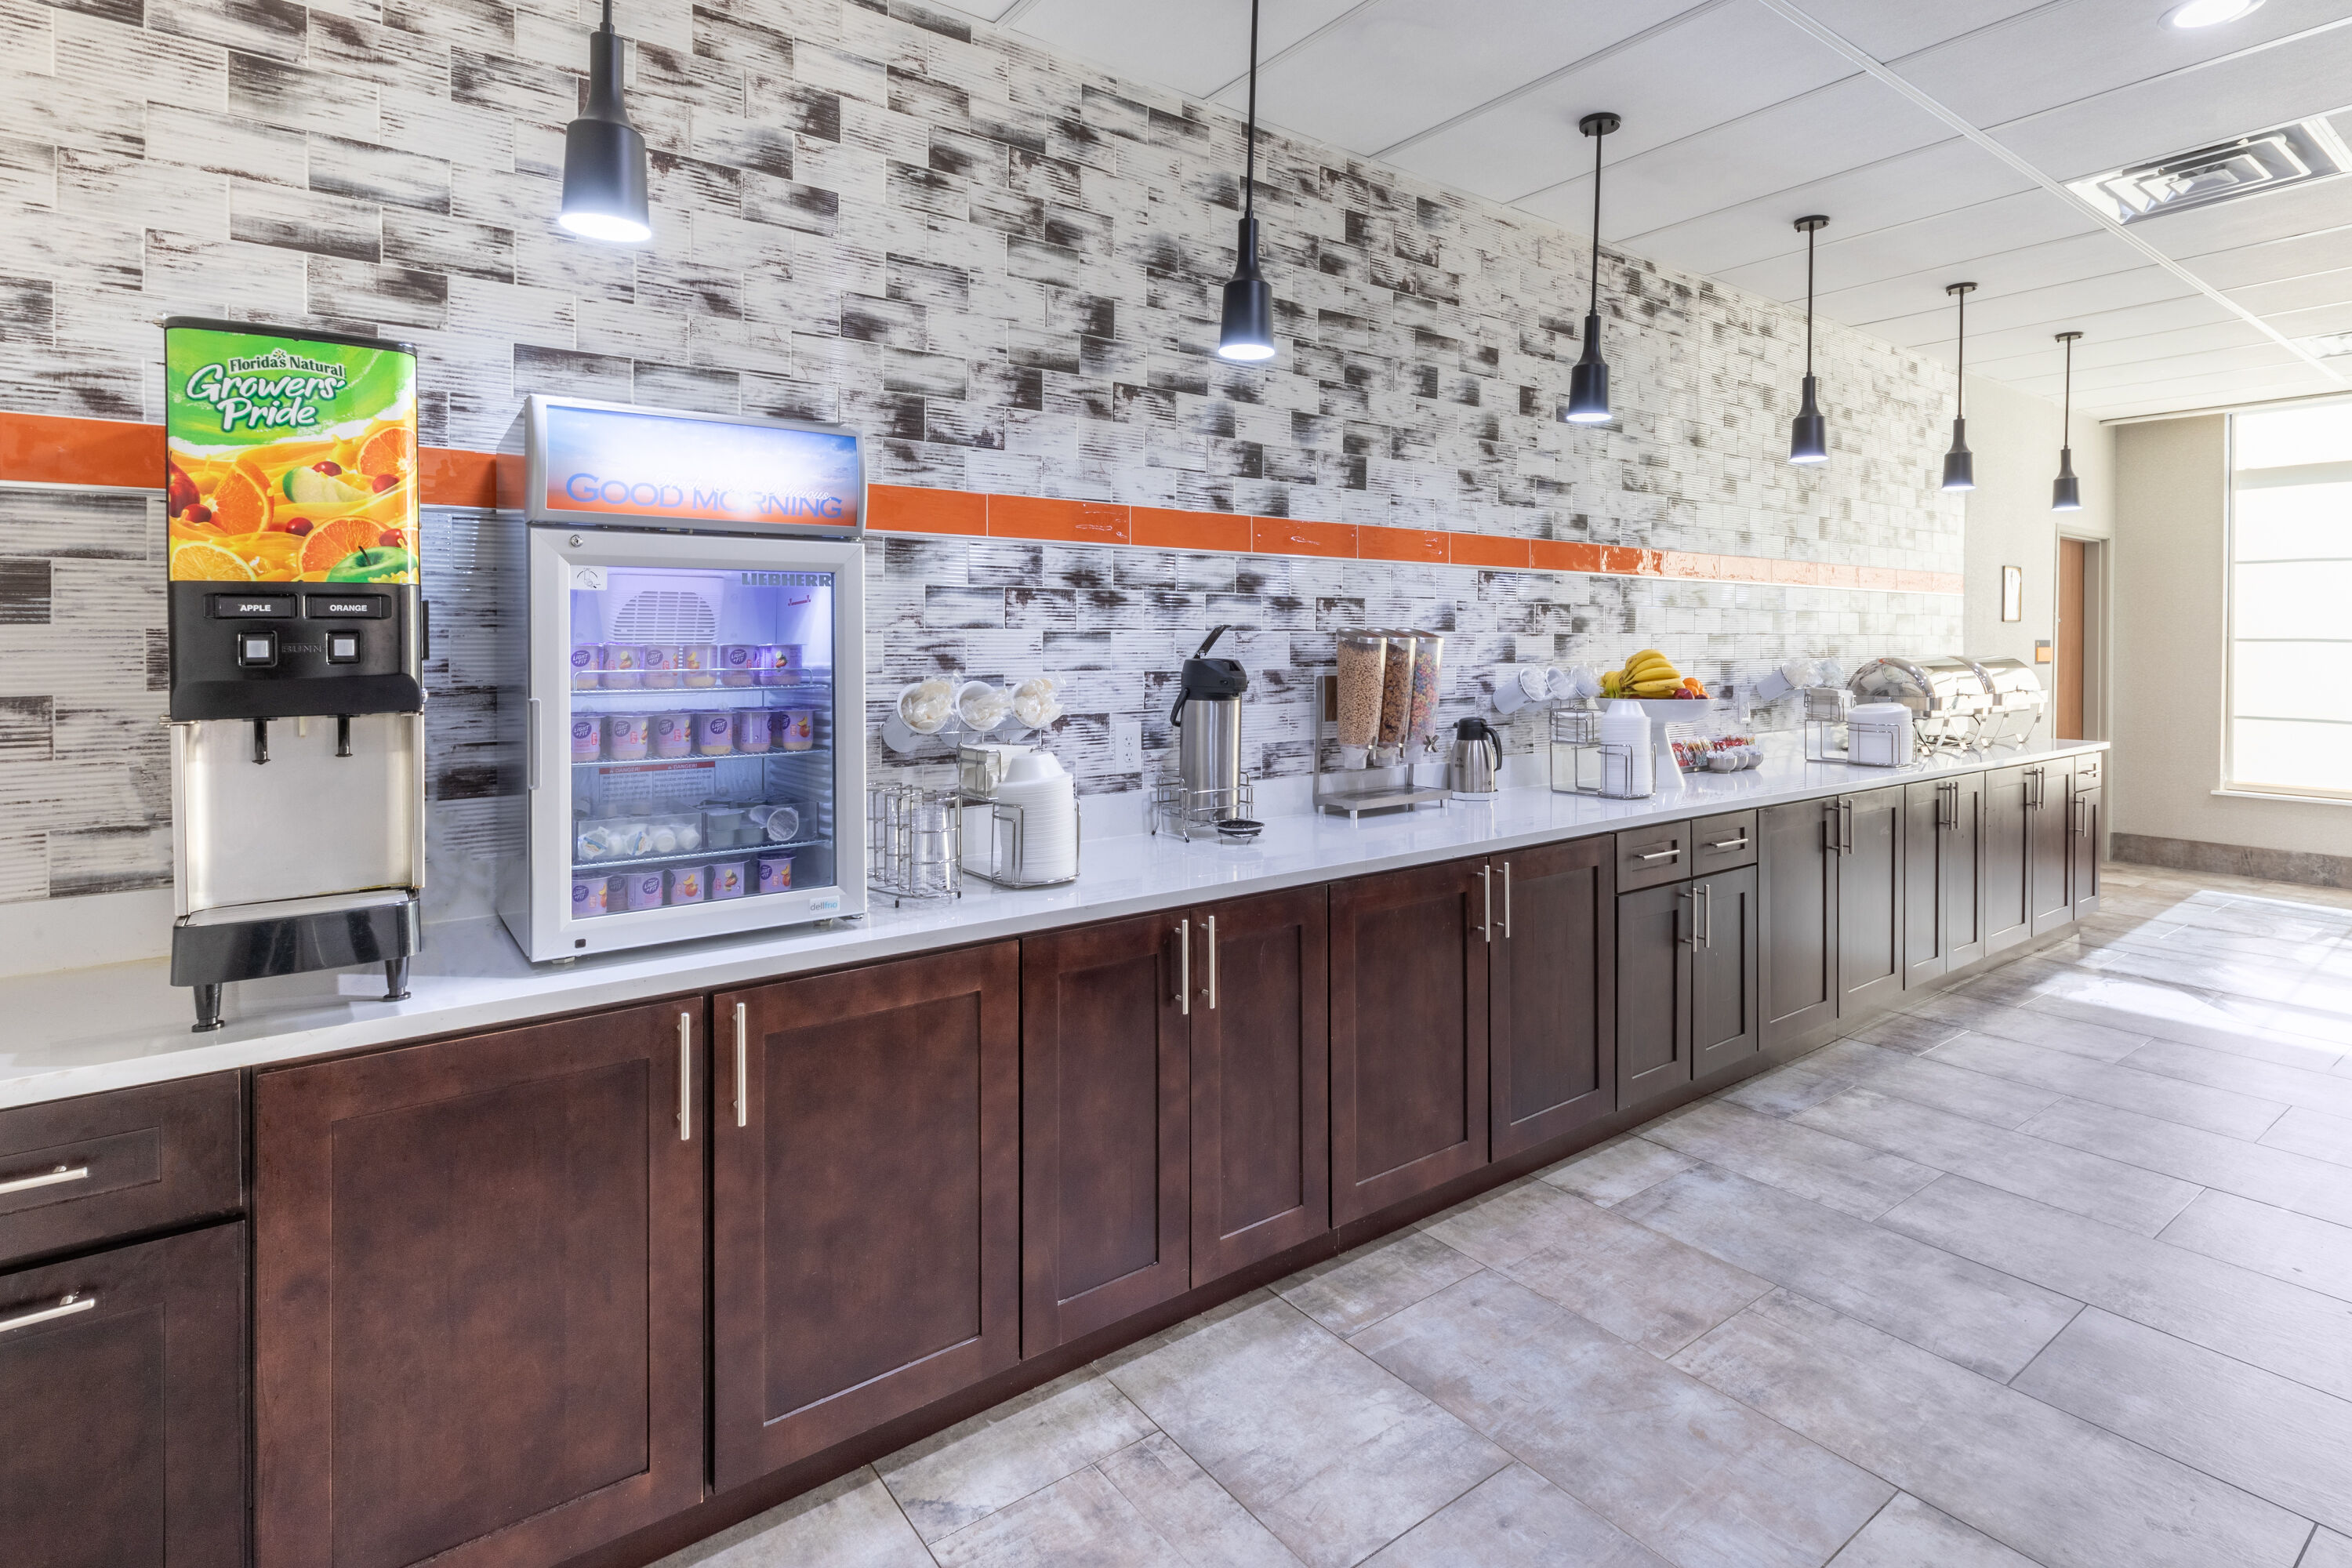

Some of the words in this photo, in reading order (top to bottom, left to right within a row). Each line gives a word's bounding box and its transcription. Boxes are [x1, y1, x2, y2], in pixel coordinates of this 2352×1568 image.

[289, 357, 343, 377] Natural
[216, 397, 317, 431] Pride
[566, 473, 684, 508] GOOD
[691, 486, 843, 518] MORNING
[742, 573, 831, 586] LIEBHERR
